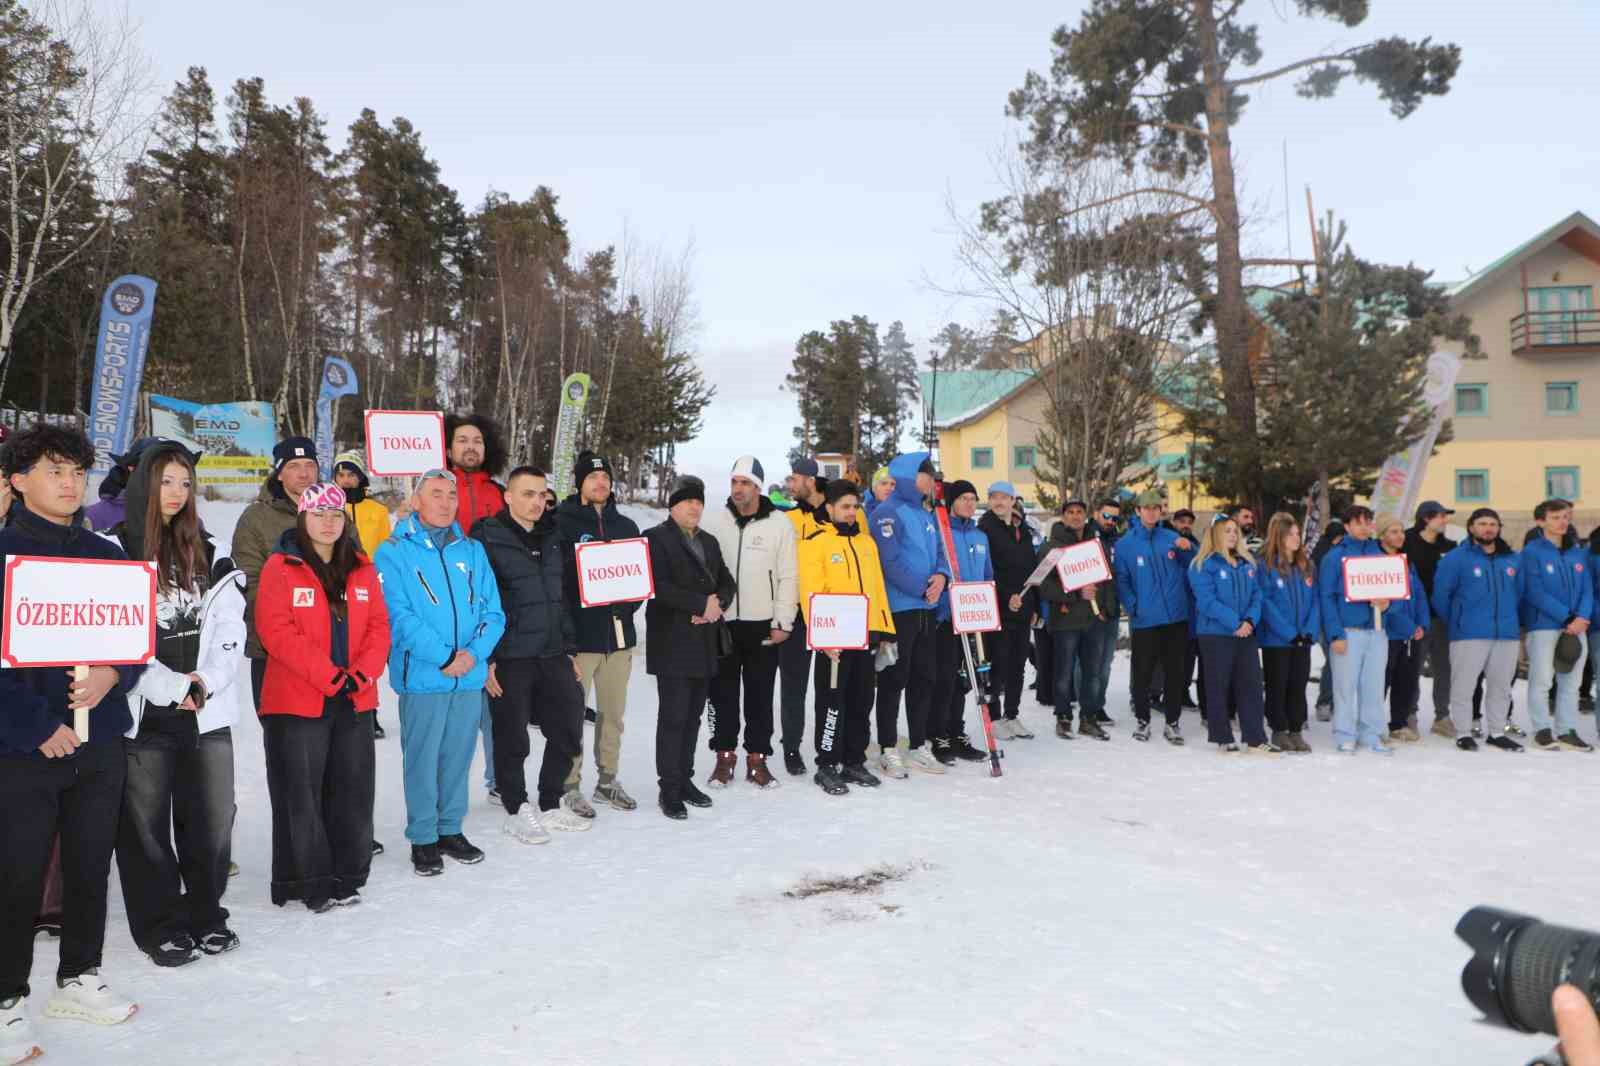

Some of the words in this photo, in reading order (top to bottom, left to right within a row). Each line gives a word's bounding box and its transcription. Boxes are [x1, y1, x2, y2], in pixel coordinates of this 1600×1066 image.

[95, 320, 131, 433] SNOWSPORTS
[195, 419, 241, 431] EMD
[379, 435, 433, 450] TONGA
[587, 563, 642, 582] KOSOVA
[16, 596, 145, 627] ÖZBEKİSTAN
